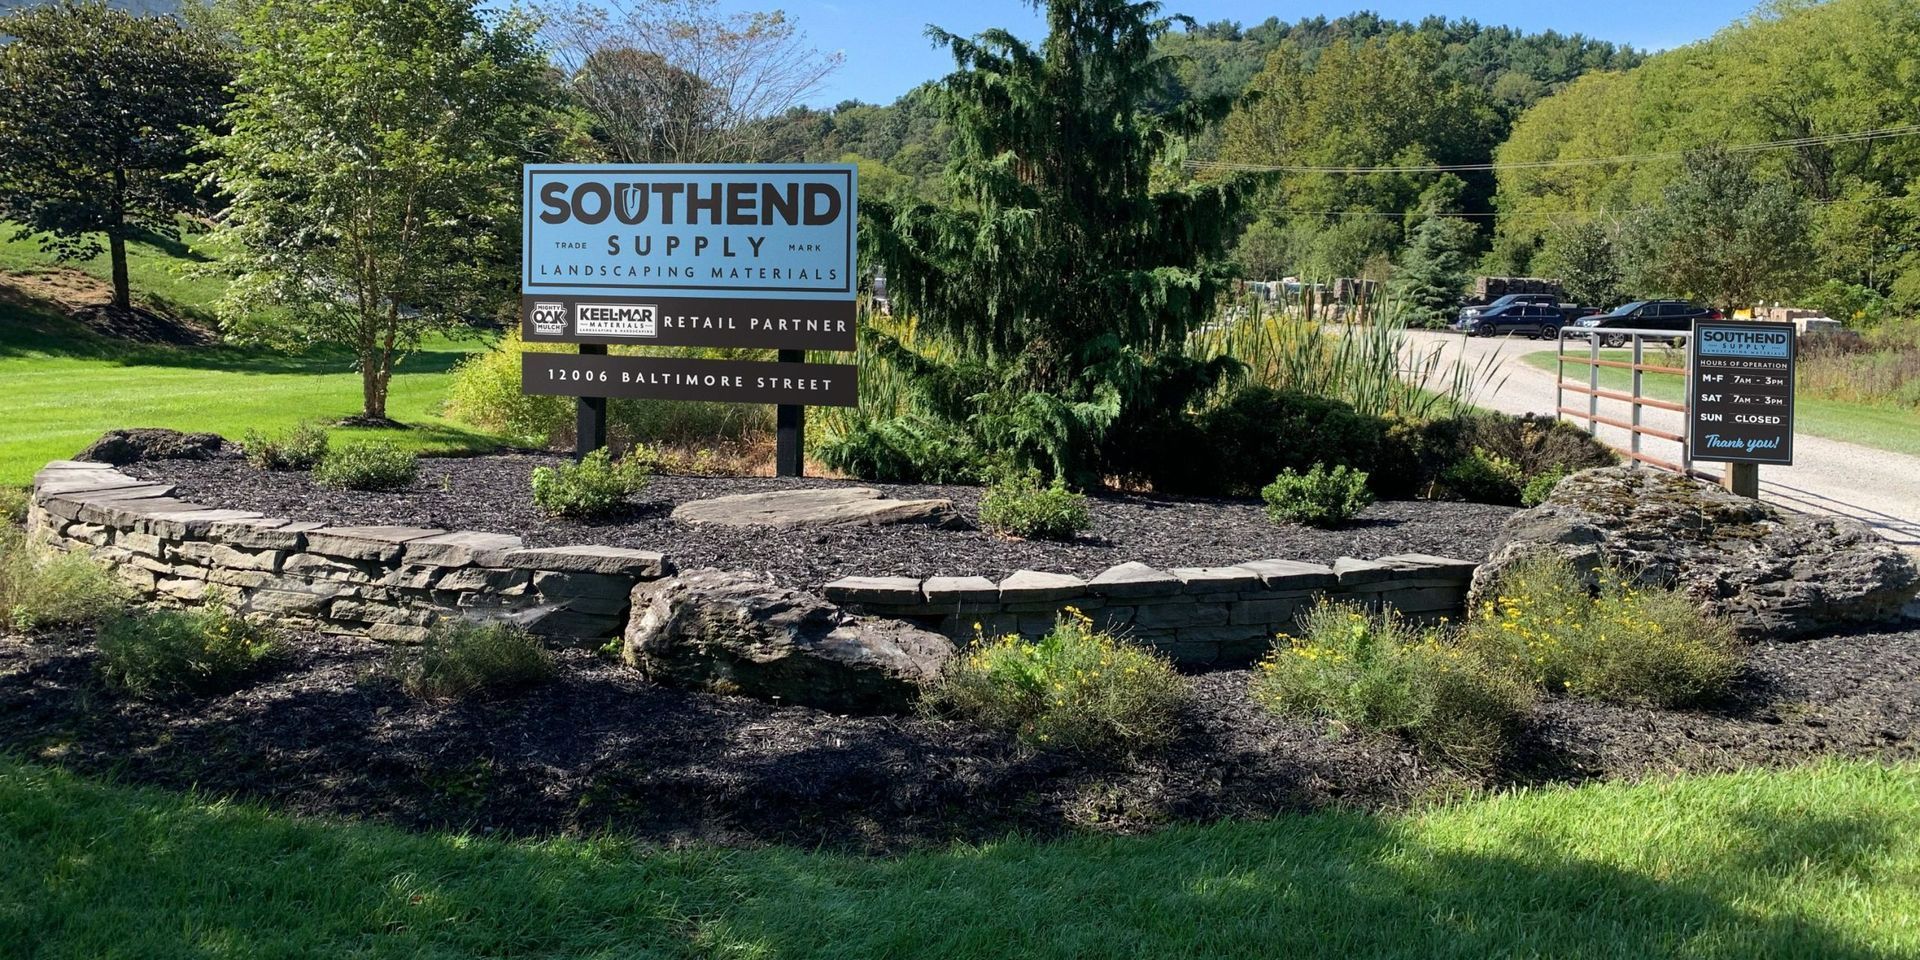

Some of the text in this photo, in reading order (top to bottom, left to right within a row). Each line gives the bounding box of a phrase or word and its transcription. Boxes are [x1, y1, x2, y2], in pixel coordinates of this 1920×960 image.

[539, 181, 842, 226] SOUTHEND
[555, 242, 587, 250] TRADE
[607, 235, 766, 258] SUPPLY
[788, 244, 822, 252] MARK
[540, 264, 837, 281] LANDSCAPING MATERIALS
[534, 310, 564, 324] OAK
[663, 316, 847, 332] RETAIL PARTNER
[1703, 331, 1786, 345] SOUTHEND
[1742, 361, 1788, 369] OPERATION
[548, 368, 832, 391] 12006 BALTIMORE STREET
[1702, 374, 1724, 383] M-F
[1701, 394, 1722, 402] SAT
[1700, 413, 1780, 424] SUN CLOSED
[1705, 433, 1780, 453] Thank you!
